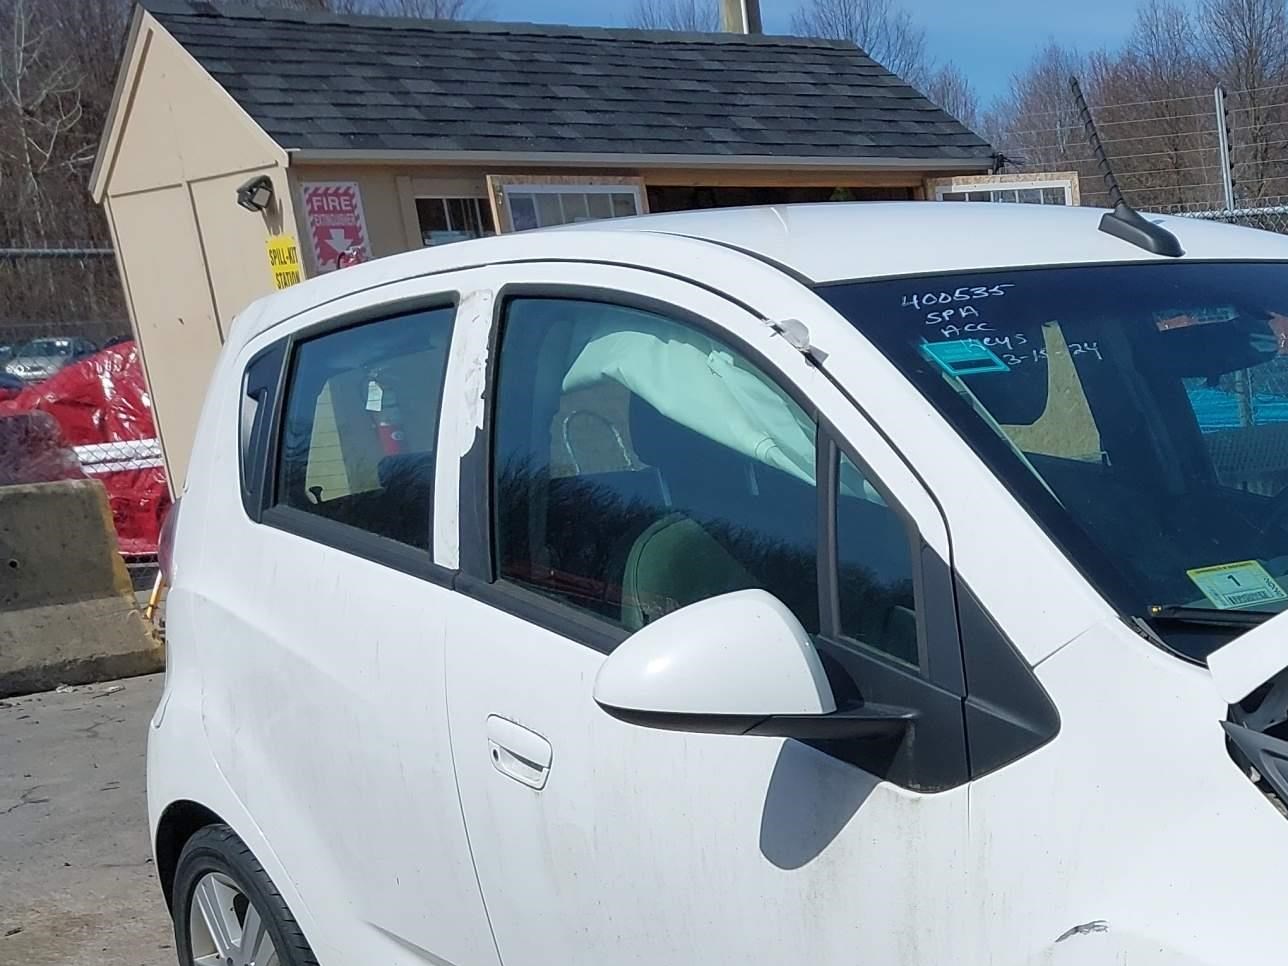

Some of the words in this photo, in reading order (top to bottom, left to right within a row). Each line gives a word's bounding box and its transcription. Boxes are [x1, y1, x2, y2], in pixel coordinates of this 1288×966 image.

[311, 195, 353, 211] FIRE
[268, 246, 299, 266] SPILL-KIT
[275, 270, 301, 290] STATION
[901, 283, 1016, 309] 400535
[925, 305, 979, 325] SPA
[941, 322, 996, 338] ACC
[1227, 574, 1241, 587] 1
